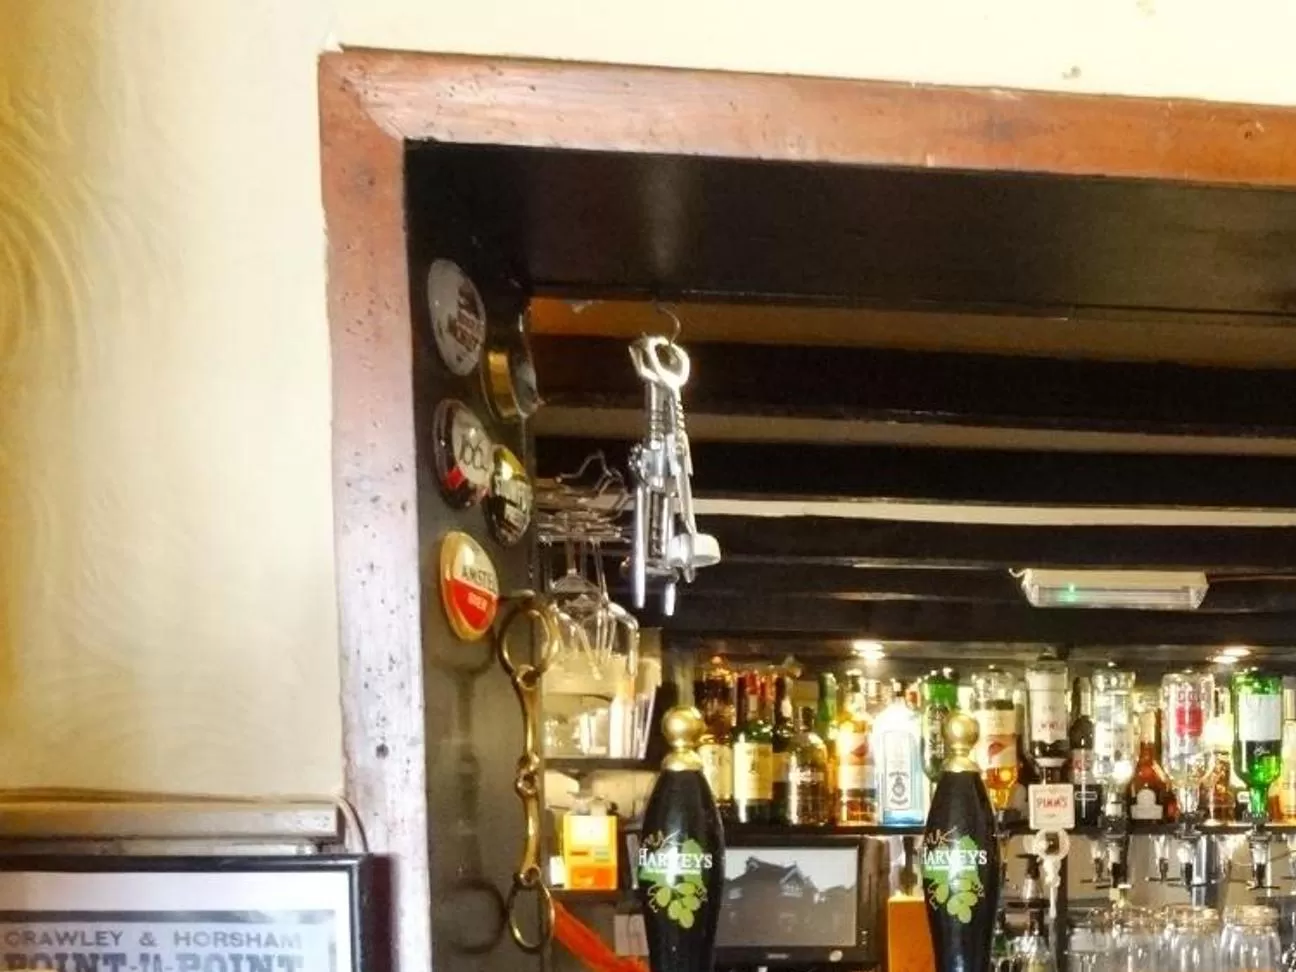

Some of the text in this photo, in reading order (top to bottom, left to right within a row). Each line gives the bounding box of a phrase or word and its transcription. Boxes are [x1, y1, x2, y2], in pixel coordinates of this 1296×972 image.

[4, 930, 303, 949] CRAWLEY & HORSHAM
